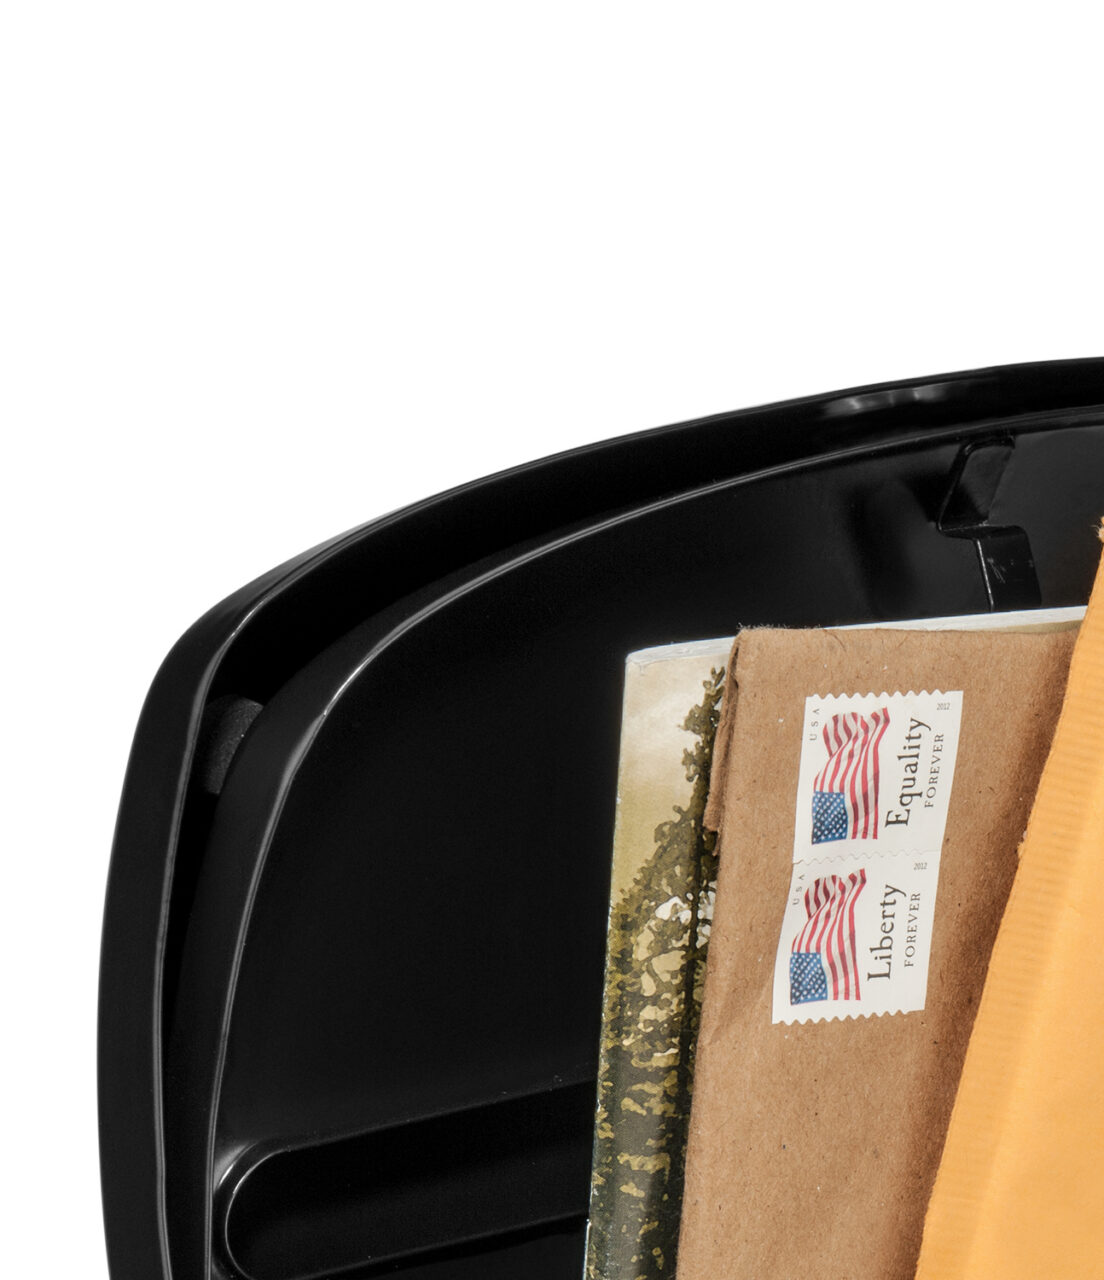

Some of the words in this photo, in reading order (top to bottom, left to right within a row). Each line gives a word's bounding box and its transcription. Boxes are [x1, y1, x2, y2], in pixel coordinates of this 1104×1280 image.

[886, 717, 931, 827] Equality
[925, 733, 944, 808] FOREVER
[867, 884, 906, 981] Liberty
[904, 892, 921, 968] FOREVER
